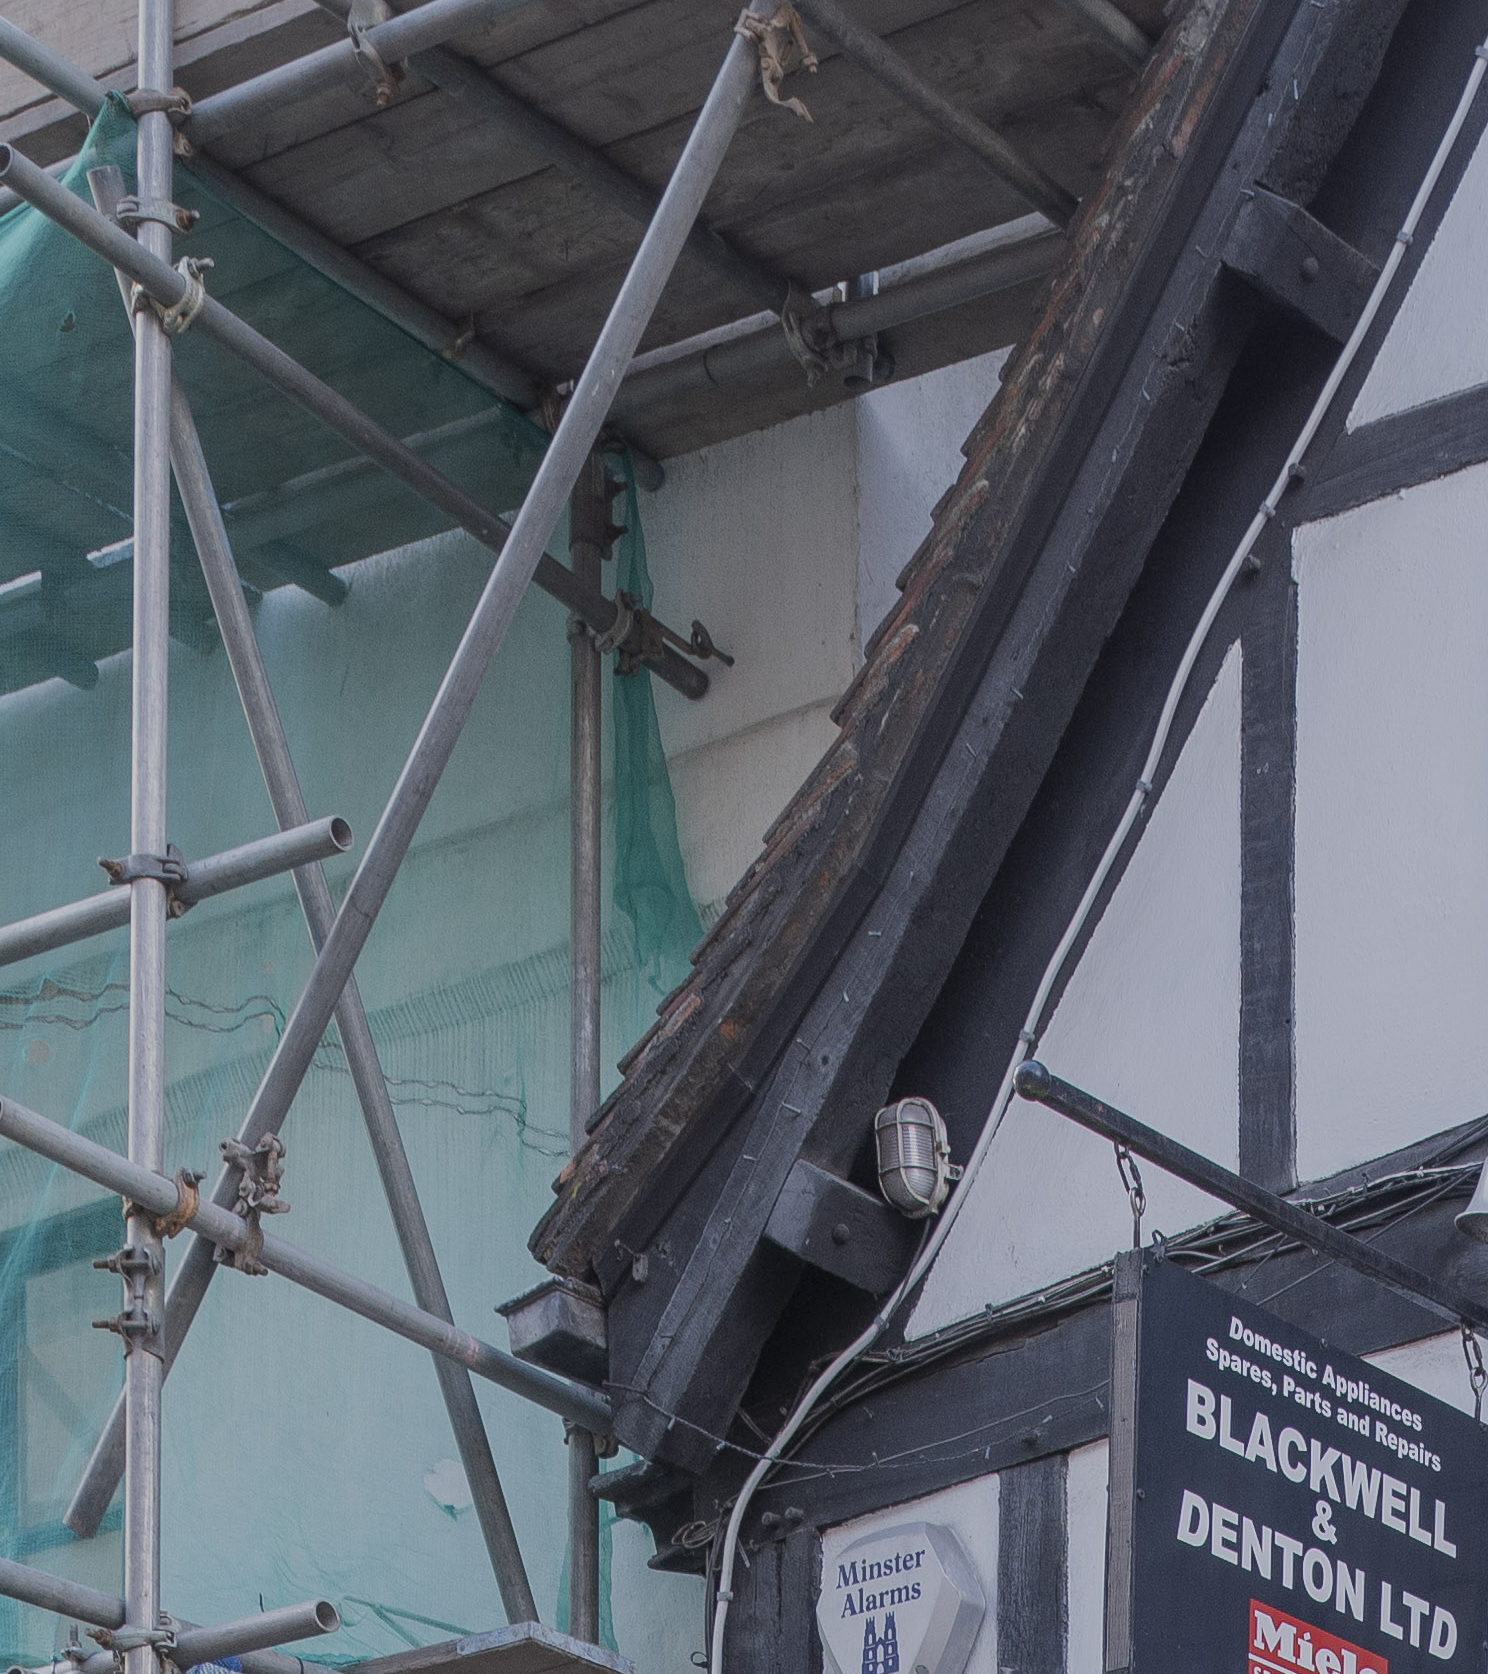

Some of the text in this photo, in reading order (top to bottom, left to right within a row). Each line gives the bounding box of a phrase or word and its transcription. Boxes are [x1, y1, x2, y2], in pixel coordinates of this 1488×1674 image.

[1206, 1338, 1442, 1473] Spares, Parts and Repairs
[1230, 1315, 1423, 1432] Domestic Appliances
[1186, 1378, 1458, 1559] BLACKWELL
[1312, 1499, 1338, 1544] &
[836, 1549, 925, 1590] Minster
[841, 1582, 921, 1619] Alarms
[1177, 1489, 1458, 1662] DENTON LTD
